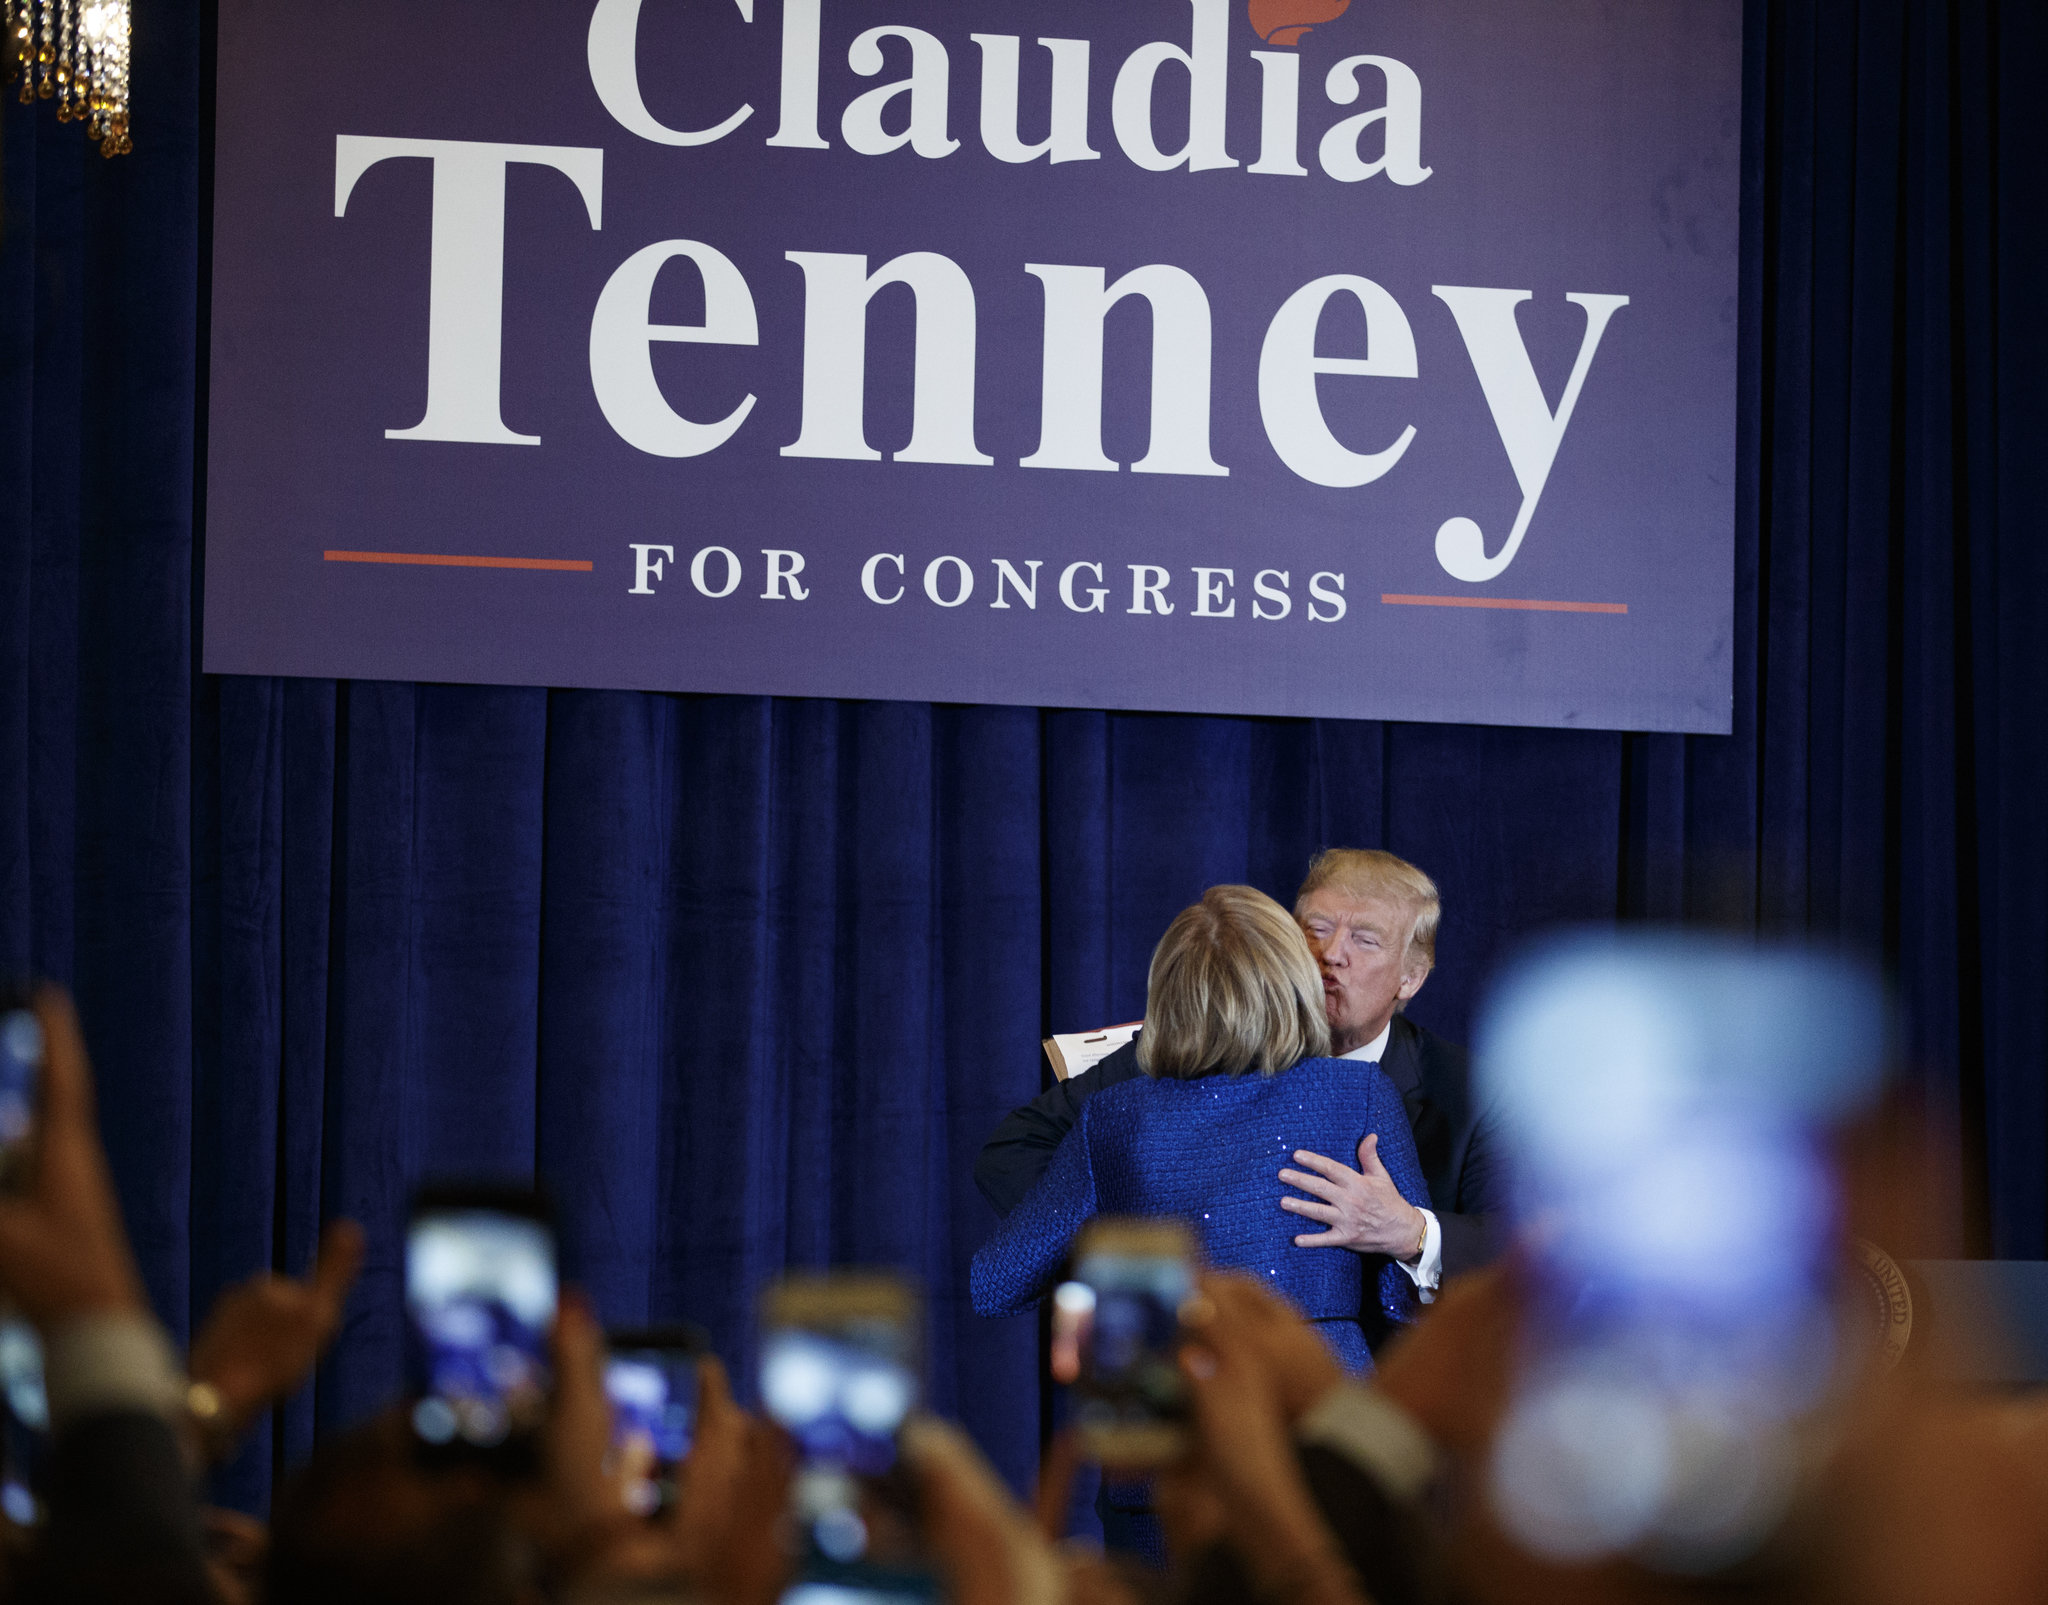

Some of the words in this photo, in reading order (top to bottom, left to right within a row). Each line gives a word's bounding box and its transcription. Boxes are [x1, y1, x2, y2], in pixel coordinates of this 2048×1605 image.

[587, 0, 1434, 187] Claudia
[334, 134, 1630, 583] Tenney
[627, 543, 810, 601] FOR
[860, 552, 1348, 623] CONGRESS
[1872, 1257, 1908, 1325] UNITED
